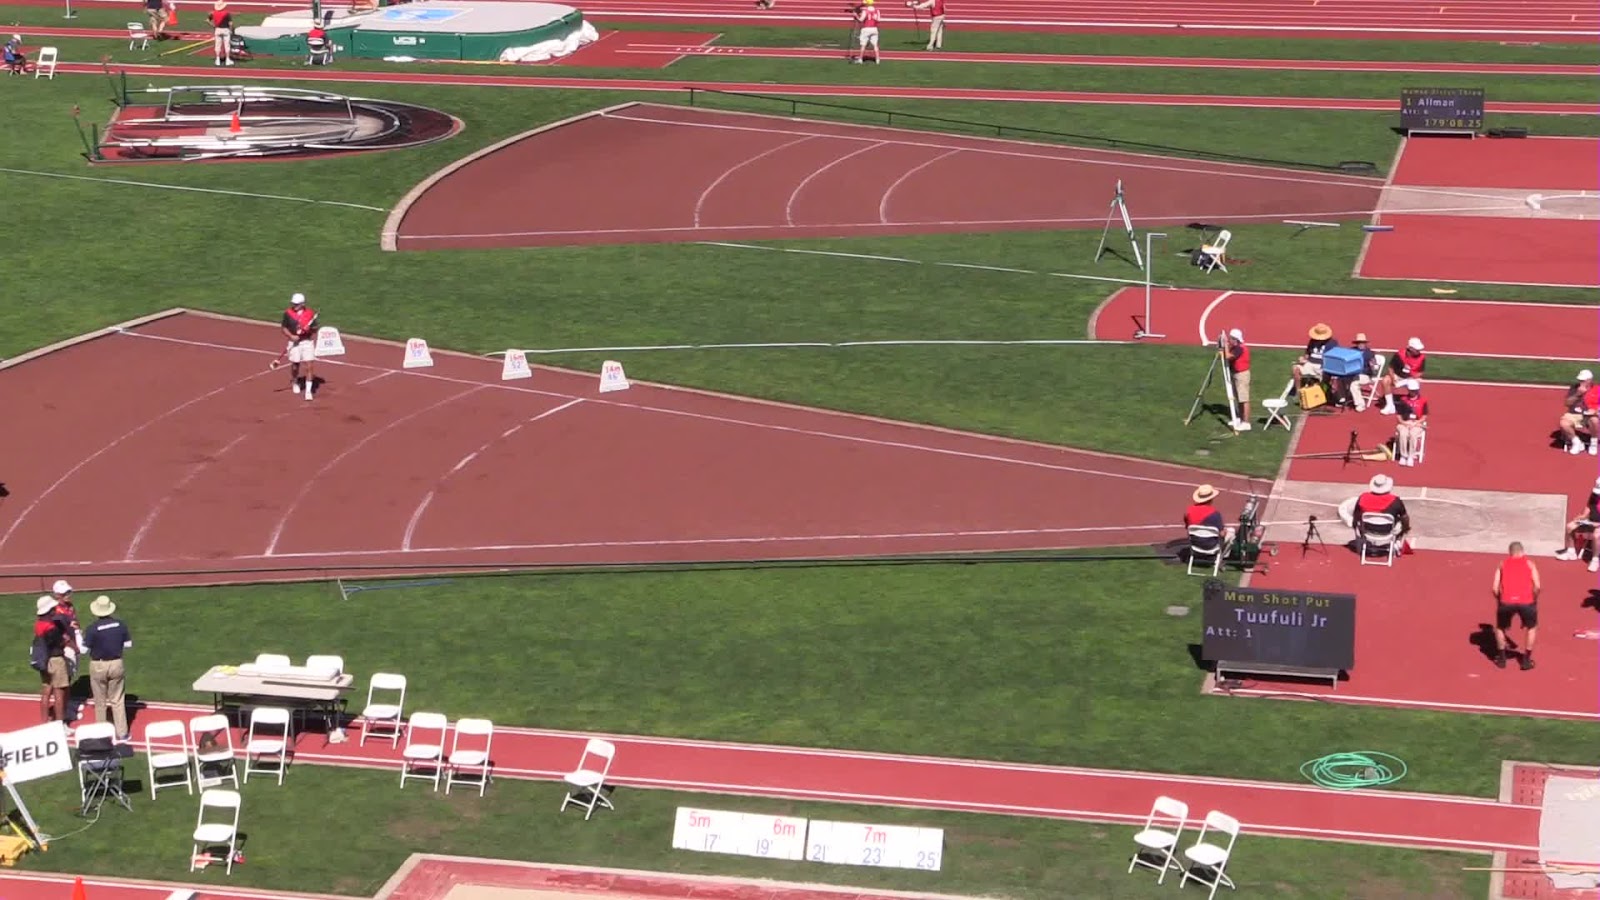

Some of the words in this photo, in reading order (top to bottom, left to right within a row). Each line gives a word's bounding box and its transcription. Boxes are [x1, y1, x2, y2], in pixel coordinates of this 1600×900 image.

[1406, 98, 1412, 106] 1
[1418, 98, 1455, 107] Allman
[1224, 591, 1254, 603] Men
[1263, 593, 1298, 605] Shot
[1306, 596, 1330, 608] Put
[1234, 608, 1303, 627] Tuufuli
[1311, 614, 1328, 628] Jr
[1206, 626, 1238, 637] Att:
[1246, 628, 1253, 638] 1
[4, 741, 59, 765] FIELD
[689, 811, 711, 828] 5m
[773, 818, 796, 836] 6m
[864, 826, 887, 844] 7m
